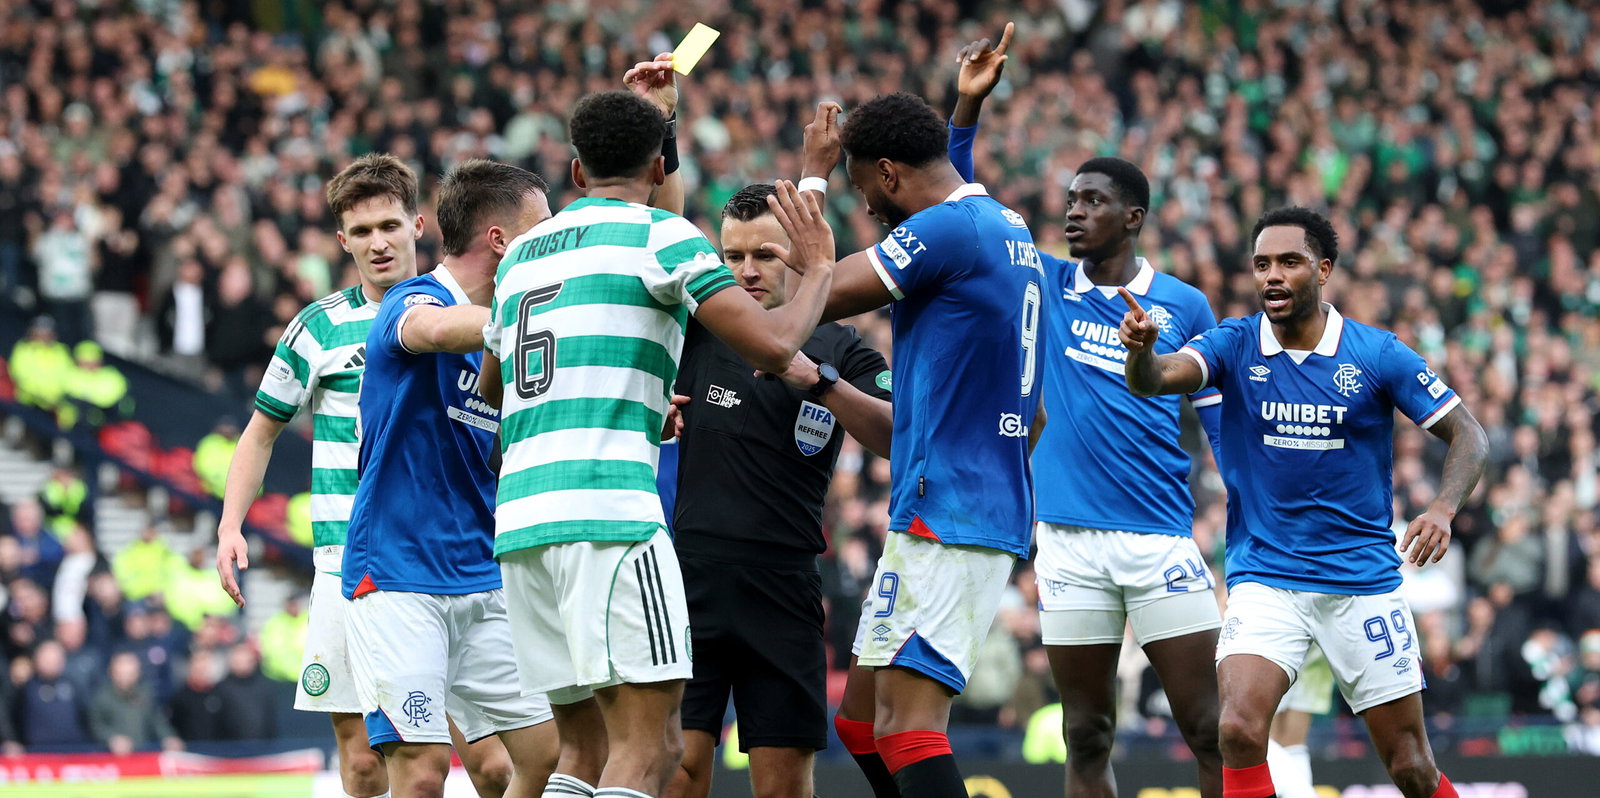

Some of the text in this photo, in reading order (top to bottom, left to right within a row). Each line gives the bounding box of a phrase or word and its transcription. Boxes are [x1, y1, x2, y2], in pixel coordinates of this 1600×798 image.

[516, 226, 590, 261] TRUSTY
[891, 226, 927, 255] OXT
[514, 280, 565, 400] 6
[1020, 280, 1042, 397] 9
[1071, 319, 1124, 348] UNIB
[802, 405, 832, 425] FIFA
[1261, 401, 1348, 425] UNIBET
[798, 424, 828, 440] REFEREE
[1273, 438, 1334, 449] ZERO% MISSION
[801, 442, 815, 453] 2025
[1164, 558, 1212, 593] 24
[874, 571, 899, 618] 9
[1363, 609, 1412, 661] 99
